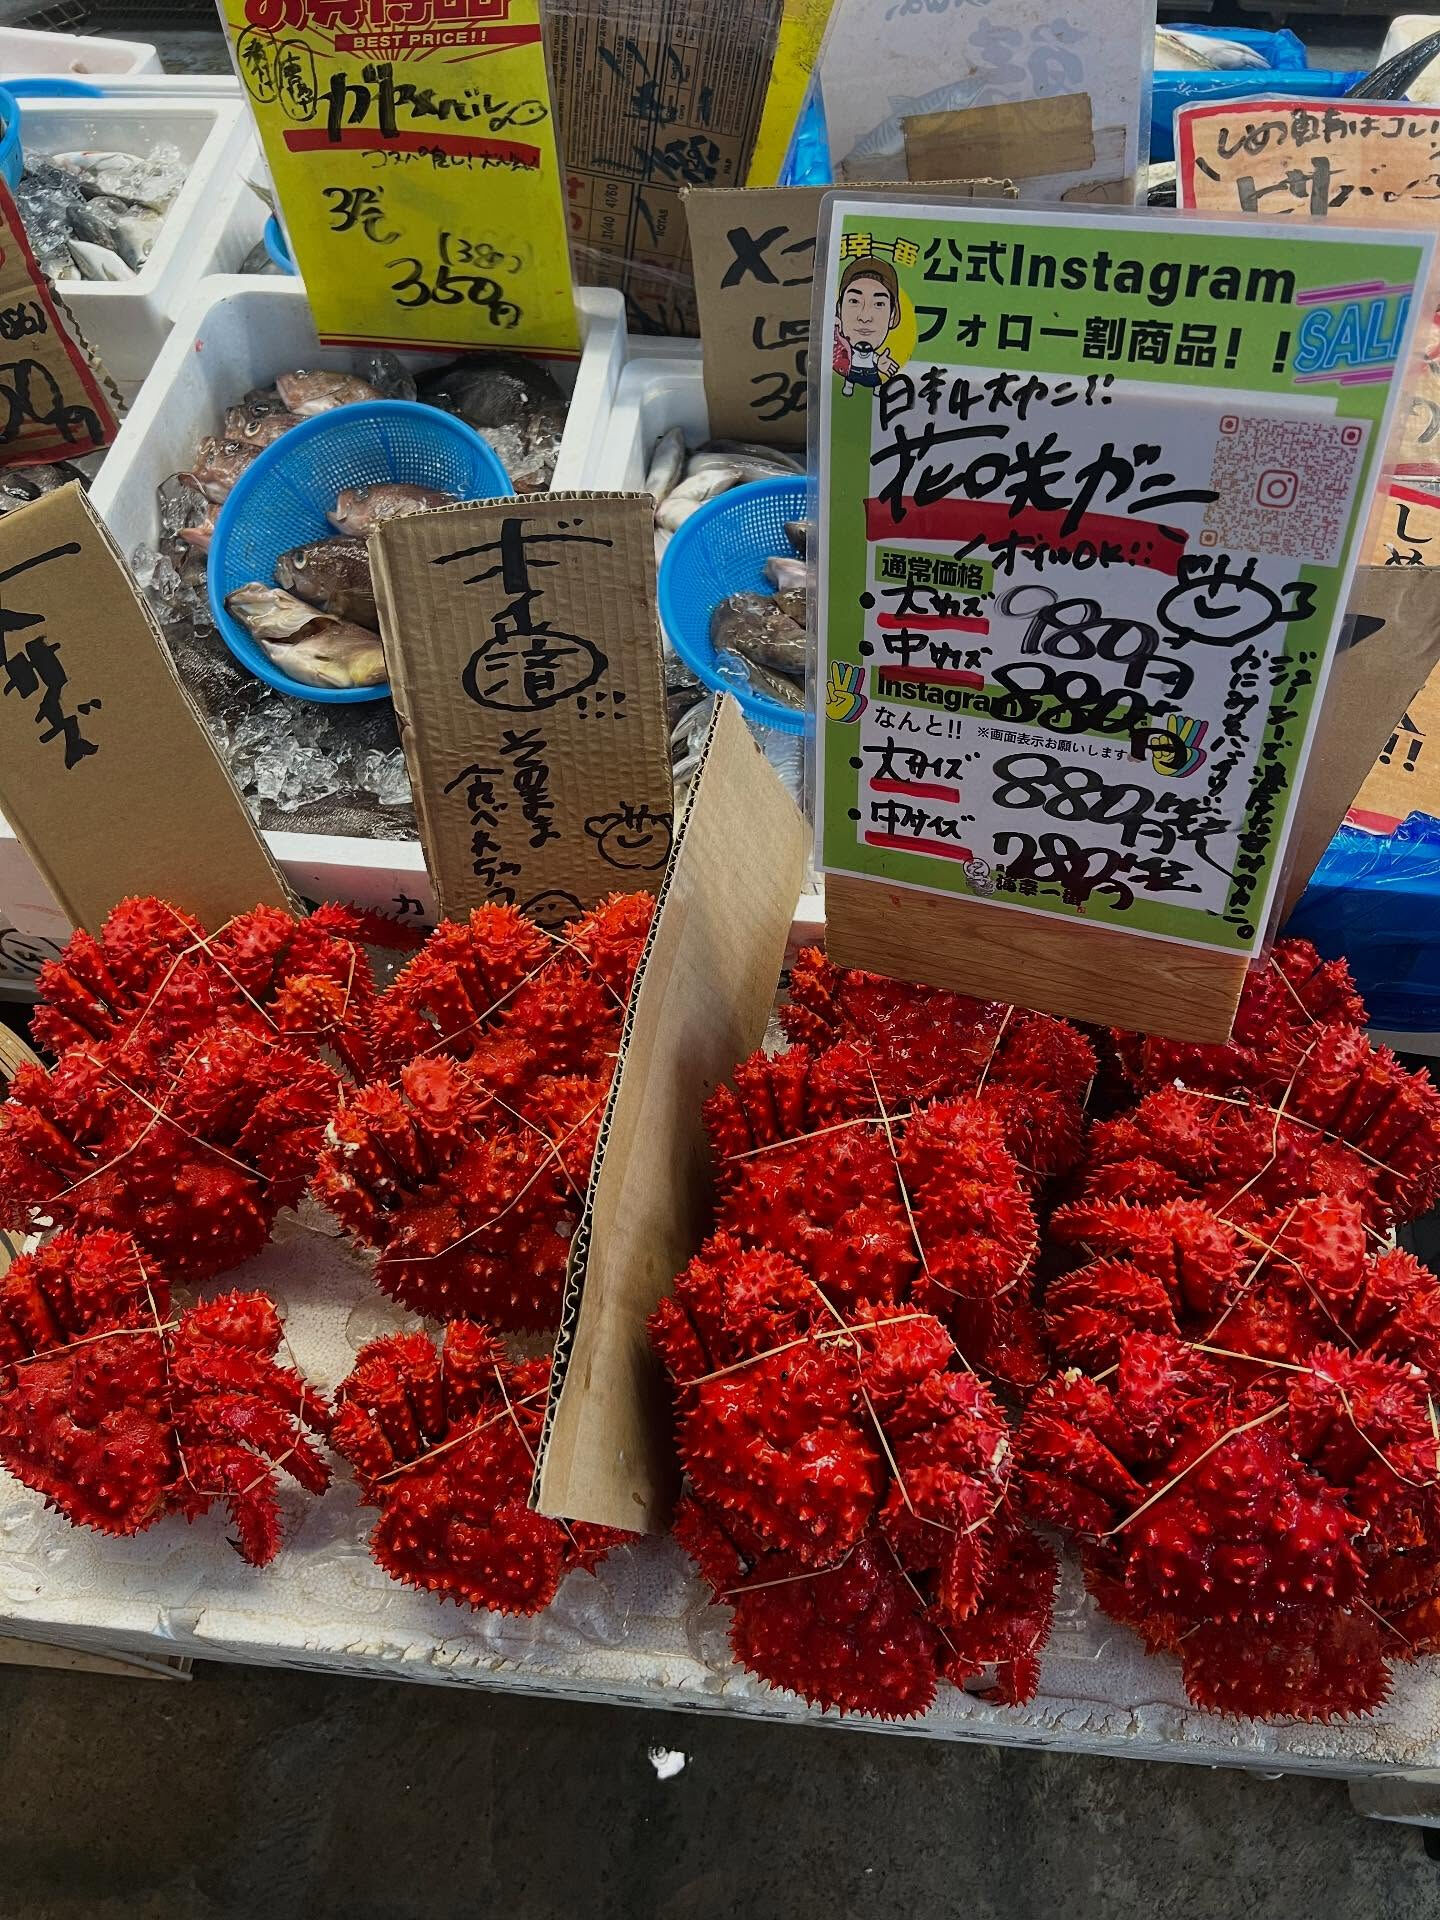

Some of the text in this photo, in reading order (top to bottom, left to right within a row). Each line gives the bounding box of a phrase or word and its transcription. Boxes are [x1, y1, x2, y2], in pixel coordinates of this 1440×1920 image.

[353, 30, 488, 49] BEST PRICE!!
[922, 236, 1297, 307] 公式Instagram
[870, 420, 1220, 537] 花咲ガニ
[881, 552, 984, 592] 通常価格
[873, 704, 963, 741] なんと!!
[862, 735, 981, 783] 大サイズ
[870, 799, 976, 840] 中サイズ
